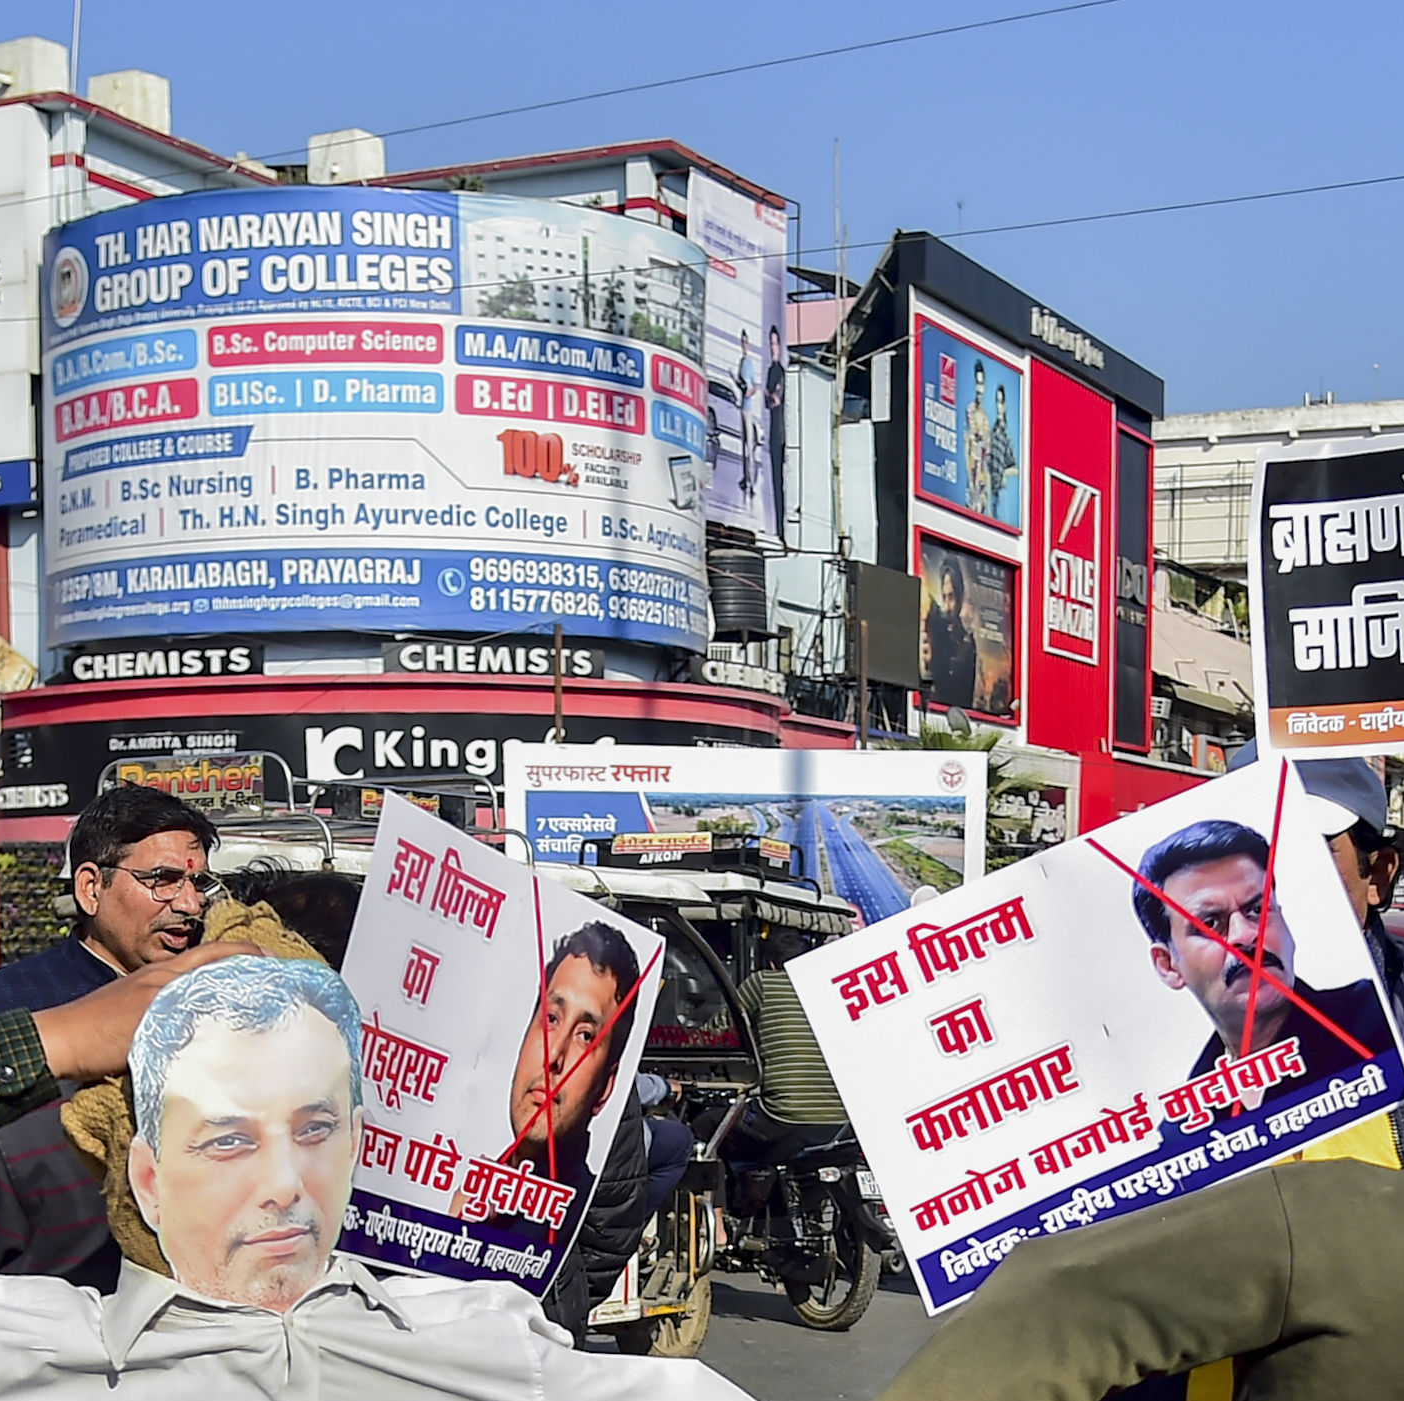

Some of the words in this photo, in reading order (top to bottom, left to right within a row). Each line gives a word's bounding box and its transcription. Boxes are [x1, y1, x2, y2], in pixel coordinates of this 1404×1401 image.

[95, 231, 131, 269] TH.
[136, 221, 191, 261] HAR
[198, 211, 342, 252] NARAYAN
[351, 210, 452, 249] SINGH
[94, 263, 193, 313] GROUP
[201, 258, 249, 298] OF
[260, 253, 454, 296] COLLEGES
[212, 333, 259, 355] B.Sc.
[263, 330, 356, 354] Computer
[360, 329, 437, 352] Science
[464, 331, 641, 379] M.A./M.Com./M.Sc.
[61, 385, 181, 435] B.B.A./B.C.A.
[214, 382, 285, 408] BLISc.
[312, 379, 337, 404] D.
[346, 378, 437, 405] Pharma
[472, 379, 533, 413] B.Ed
[562, 388, 637, 427] D.El.Ed
[112, 439, 162, 463] COLLEGE
[164, 438, 176, 457] &
[177, 432, 234, 456] COURSE
[572, 442, 643, 466] SCHOLARSHIP
[121, 480, 161, 501] B.Sc
[168, 471, 253, 498] Nursing
[295, 468, 318, 491] B.
[328, 467, 426, 490] Pharma
[584, 463, 621, 477] FACILITY
[584, 474, 628, 490] AVAILABLE
[60, 513, 145, 548] Paramedical
[179, 508, 210, 531] Th.
[219, 505, 266, 529] H.N.
[276, 502, 345, 530] Singh
[354, 503, 477, 532] Ayurvedic
[485, 505, 568, 537] College
[601, 515, 642, 541] B.Sc.
[127, 559, 277, 595] KARAILABAGH,
[282, 557, 421, 586] PRAYAGRAJ
[470, 557, 604, 592] 9696938315,
[1049, 550, 1095, 605] STYLE
[470, 587, 604, 621] 8115776826,
[73, 647, 252, 681] CHEMISTS
[398, 644, 595, 676] CHEMISTS
[186, 734, 237, 748] SINGH
[1287, 711, 1345, 736] निवेदक
[374, 725, 523, 776] King
[119, 759, 262, 793] Panther
[525, 764, 606, 788] सुपरफास्ट
[609, 764, 672, 784] रफ्तार
[536, 818, 546, 831] 7
[387, 838, 434, 899] इस
[433, 848, 507, 939] फिल्म
[403, 945, 443, 1006] का
[831, 950, 904, 1021] इस
[908, 895, 1035, 985] फिल्म
[932, 998, 994, 1056] का
[906, 1045, 1080, 1153] कलाकार
[910, 1158, 1027, 1232] मनोज
[1159, 1037, 1306, 1132] मुर्दाबाद
[404, 1132, 463, 1192] पांडे
[463, 1156, 575, 1230] मुर्दाबाद
[1115, 1150, 1210, 1202] परशुराम
